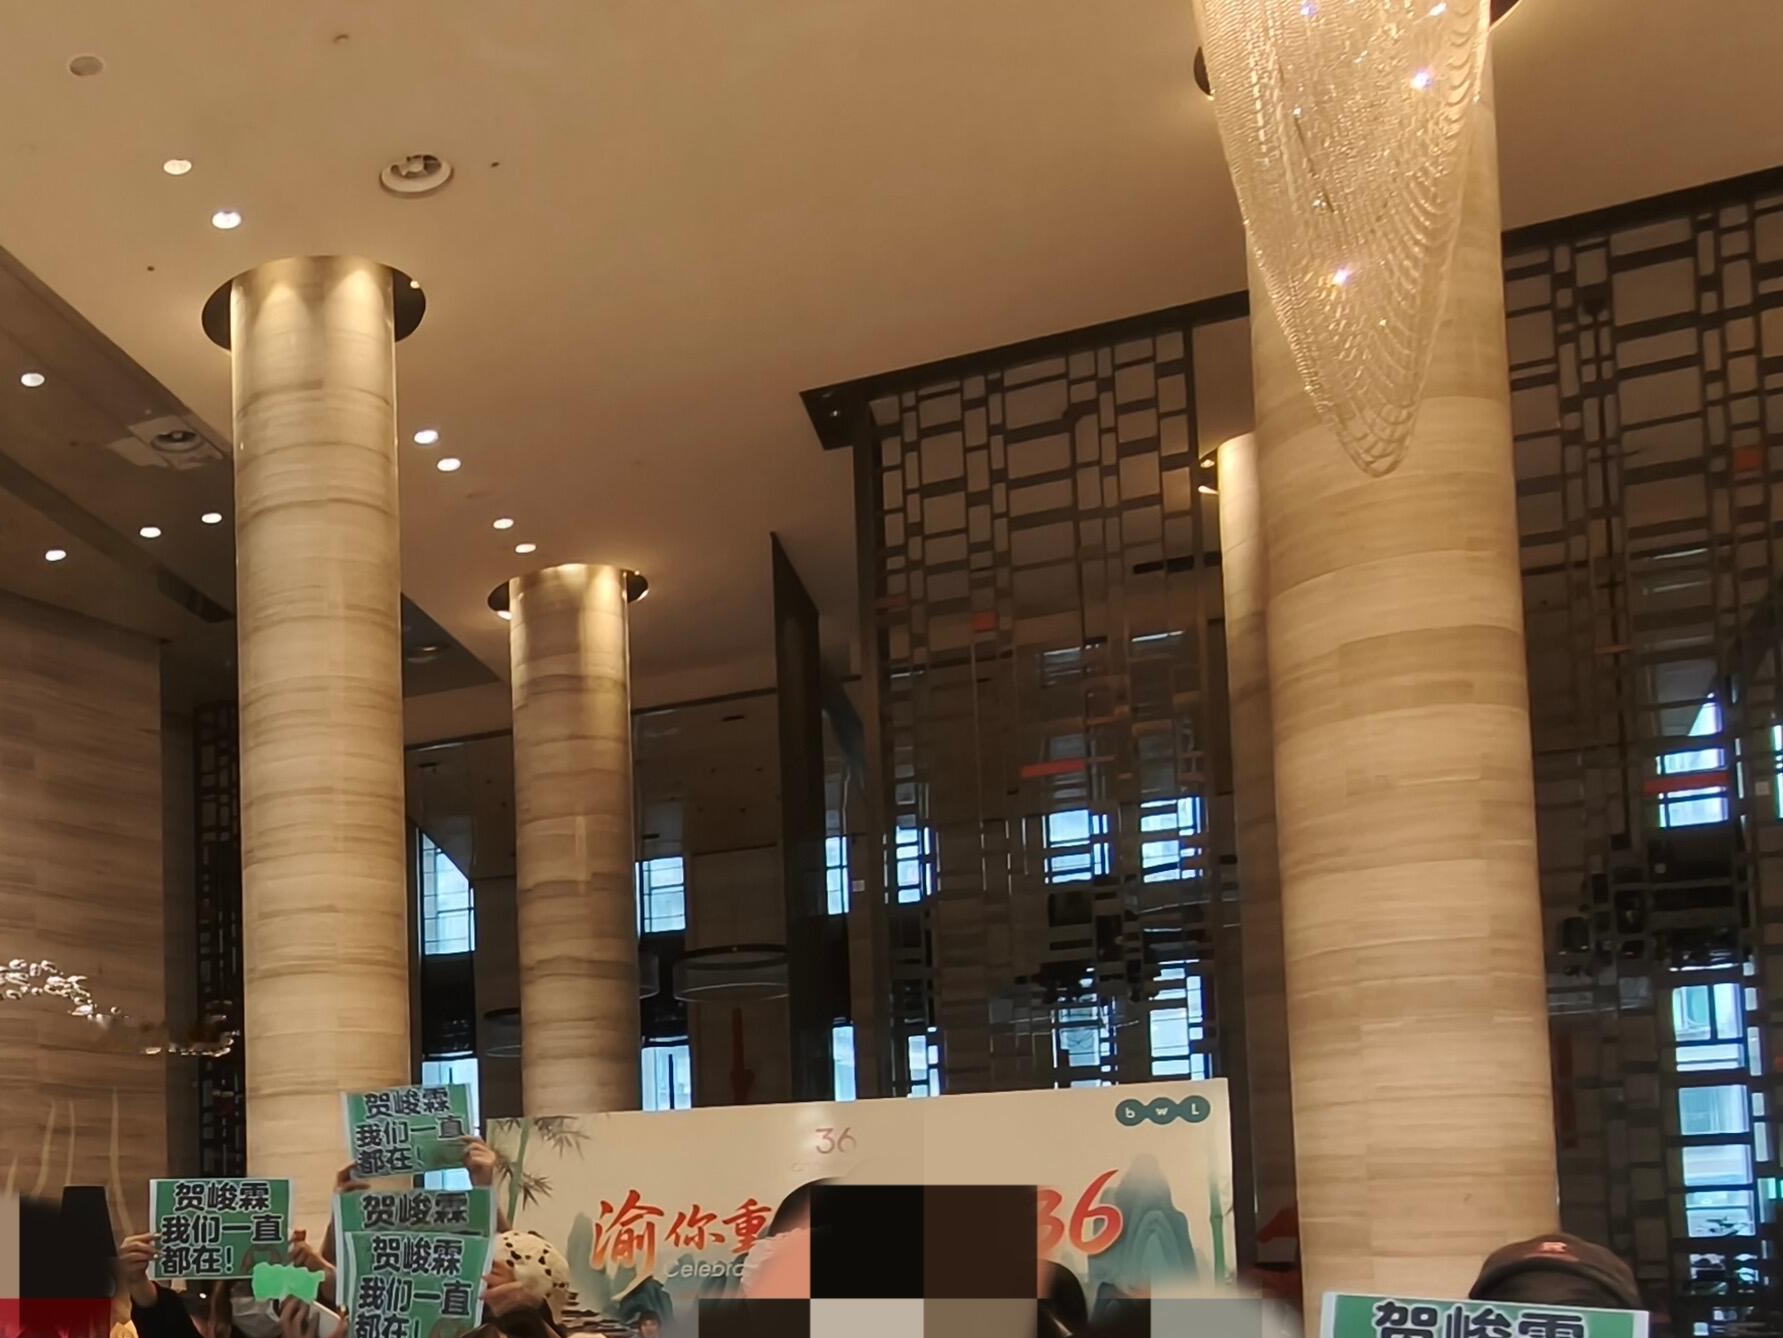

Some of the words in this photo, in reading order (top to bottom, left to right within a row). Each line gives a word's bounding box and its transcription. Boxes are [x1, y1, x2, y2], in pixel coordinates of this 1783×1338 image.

[365, 1088, 450, 1118] 贺峻霖
[355, 1115, 464, 1147] 我们一直
[815, 1126, 857, 1154] 36
[174, 1182, 269, 1211] 贺峻霖
[362, 1192, 467, 1227] 贺峻霖
[161, 1215, 282, 1244] 我们一直
[161, 1246, 232, 1275] 都在!
[372, 1235, 463, 1275] 贺峻霖
[358, 1276, 472, 1317] 我们一直
